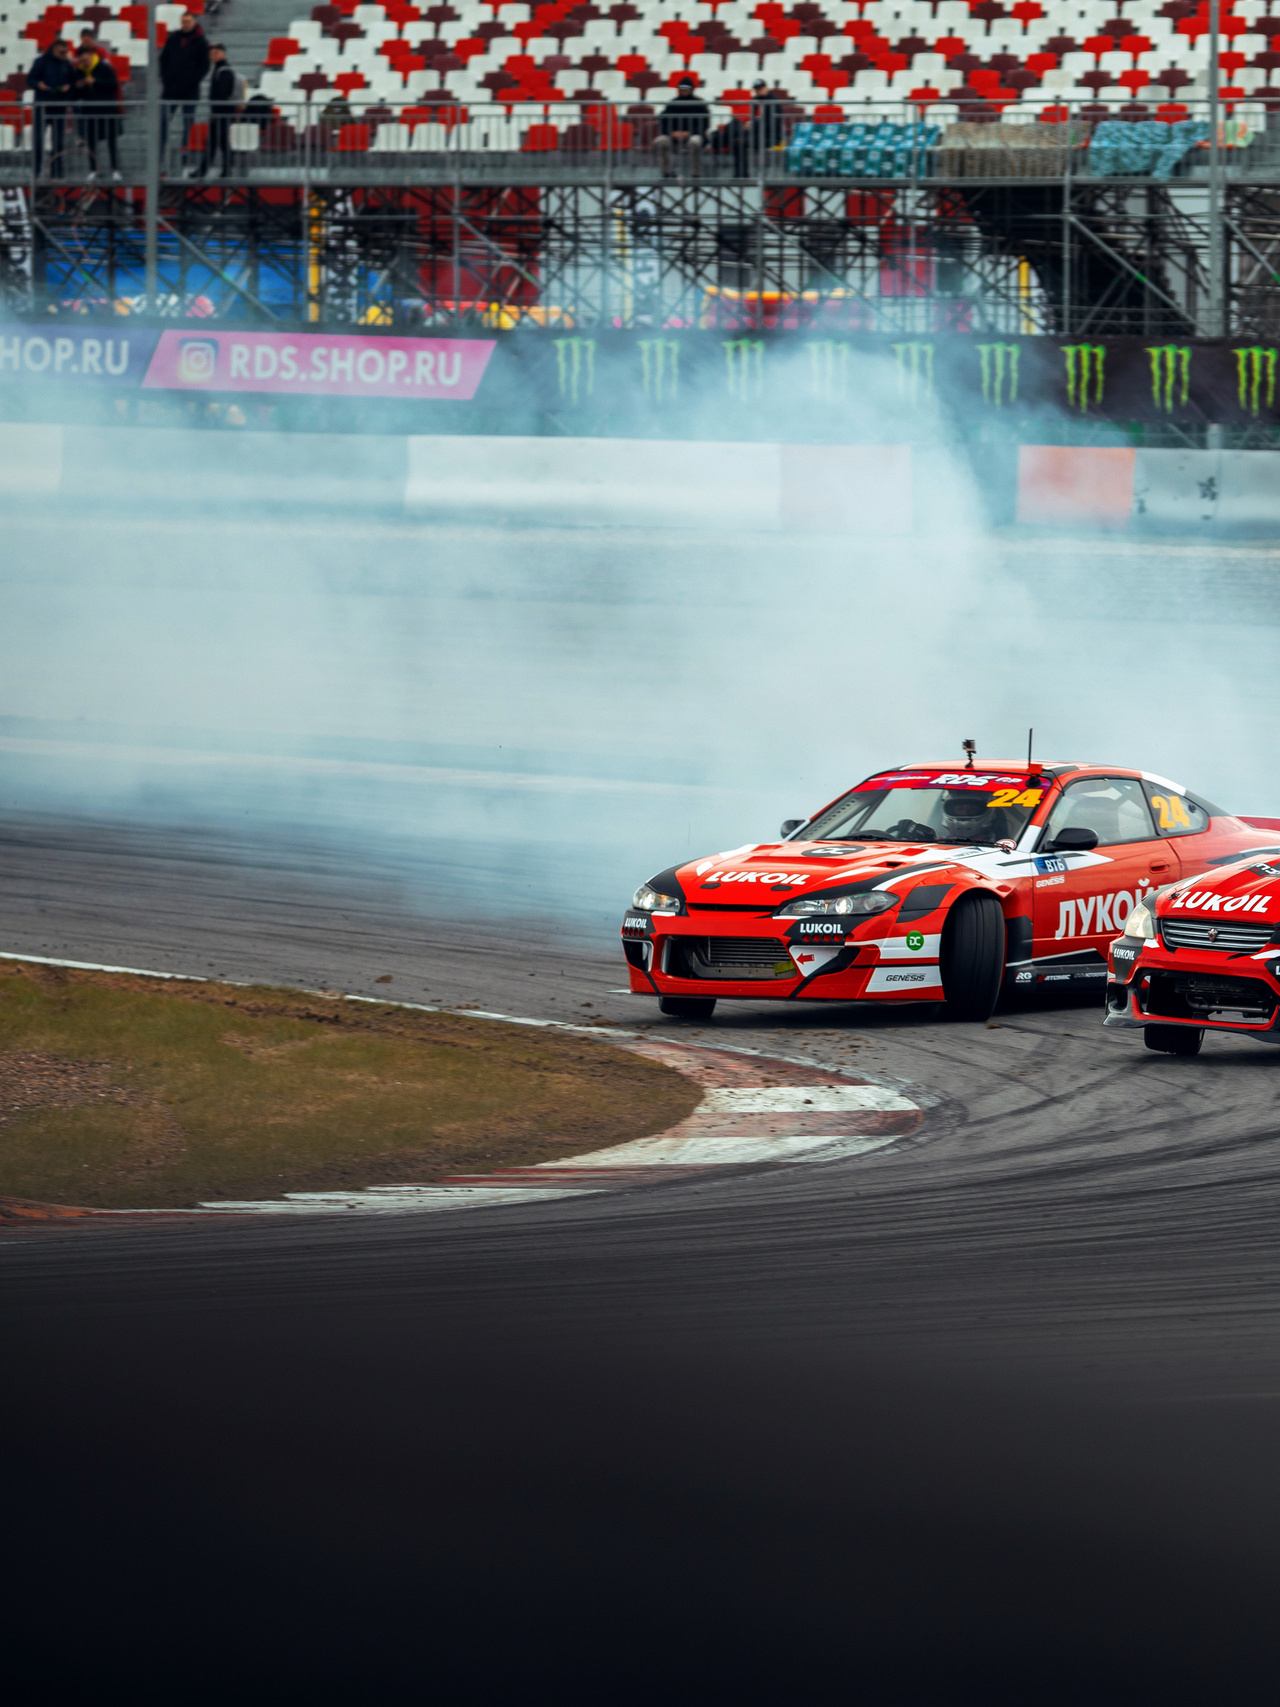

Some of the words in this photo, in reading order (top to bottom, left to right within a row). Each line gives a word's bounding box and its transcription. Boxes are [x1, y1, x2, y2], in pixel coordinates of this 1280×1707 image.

[230, 344, 462, 386] RDS.SHOP.RU
[929, 774, 998, 786] RDS
[986, 788, 1044, 808] 24
[1151, 796, 1190, 828] 24
[705, 872, 810, 885] LUKOIL
[1036, 875, 1065, 888] GENESIS
[1172, 891, 1273, 913] LUKOIL
[1055, 878, 1173, 940] ЛУКО
[624, 917, 648, 928] LUKOIL
[800, 923, 843, 934] LUKOIL
[1113, 948, 1135, 960] LUKOIL
[886, 974, 925, 982] GENESIS
